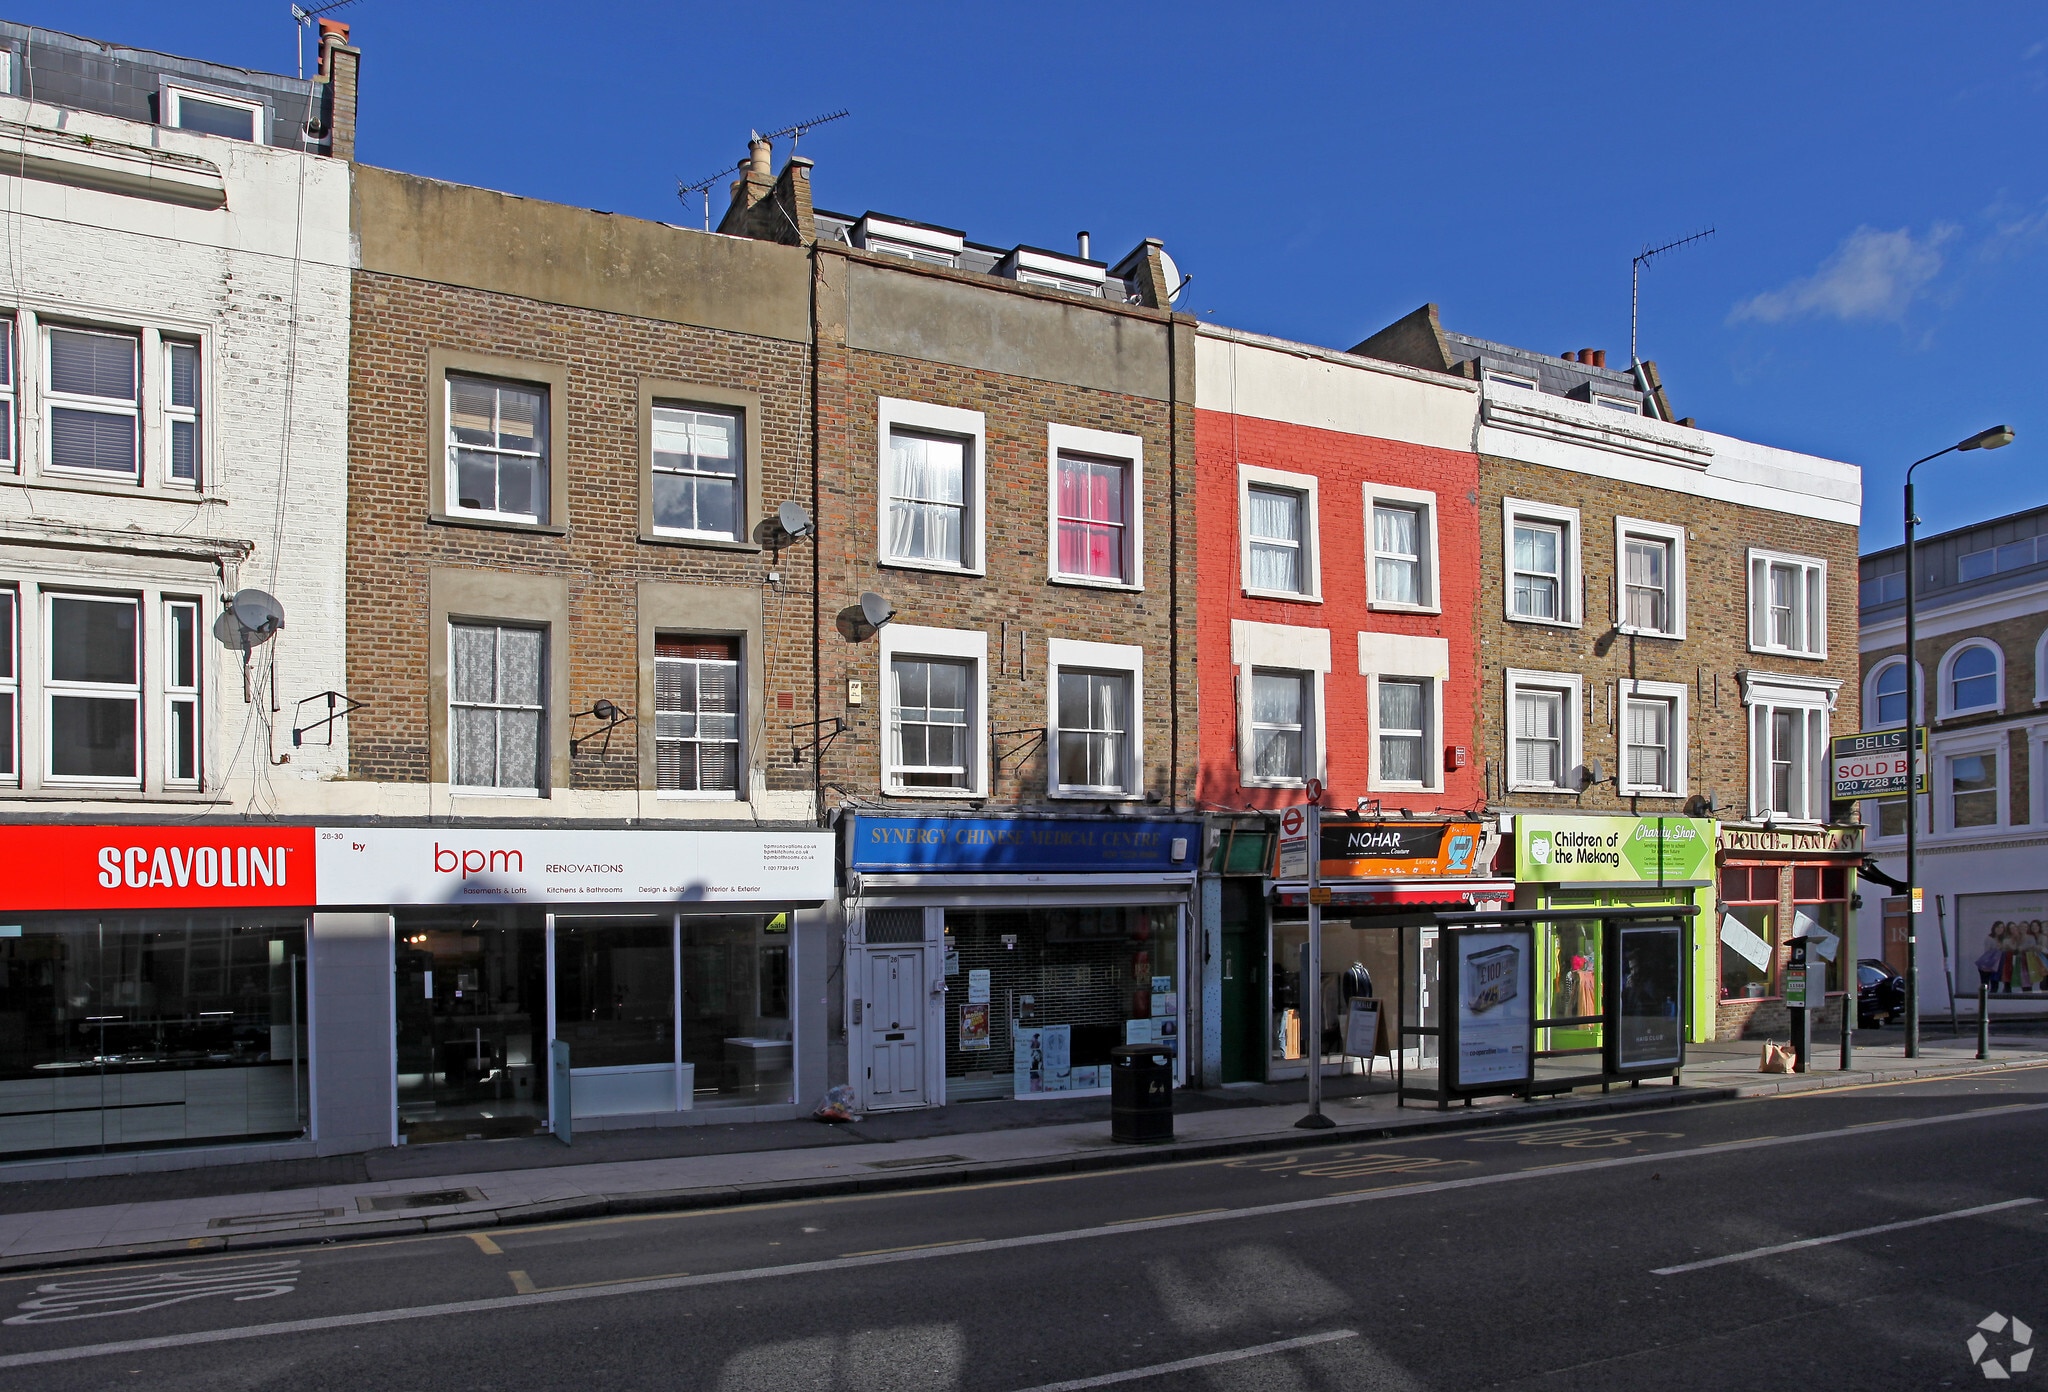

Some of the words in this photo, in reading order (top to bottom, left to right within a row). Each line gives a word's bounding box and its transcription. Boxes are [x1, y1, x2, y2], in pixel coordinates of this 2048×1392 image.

[1856, 734, 1900, 750] BELLS
[1838, 762, 1888, 778] SOLD
[1308, 782, 1318, 799] X
[1838, 781, 1858, 791] 020
[1862, 778, 1889, 788] 7228
[872, 828, 950, 844] SYNERGY
[956, 829, 1025, 845] CHINESE
[1031, 830, 1097, 846] MEDICAL
[1102, 832, 1160, 847] CENTRE
[1348, 832, 1401, 848] NOHAR
[1555, 832, 1602, 847] Children
[1606, 832, 1618, 847] of
[1673, 825, 1696, 841] Shop
[352, 842, 366, 852] by
[434, 842, 522, 880] bpm
[1555, 848, 1573, 863] the
[1576, 848, 1620, 868] Mekong
[98, 846, 287, 888] SCAVOLINI
[546, 864, 624, 873] RENOVATIONS
[1795, 947, 1804, 960] P
[1480, 962, 1501, 985] £100
